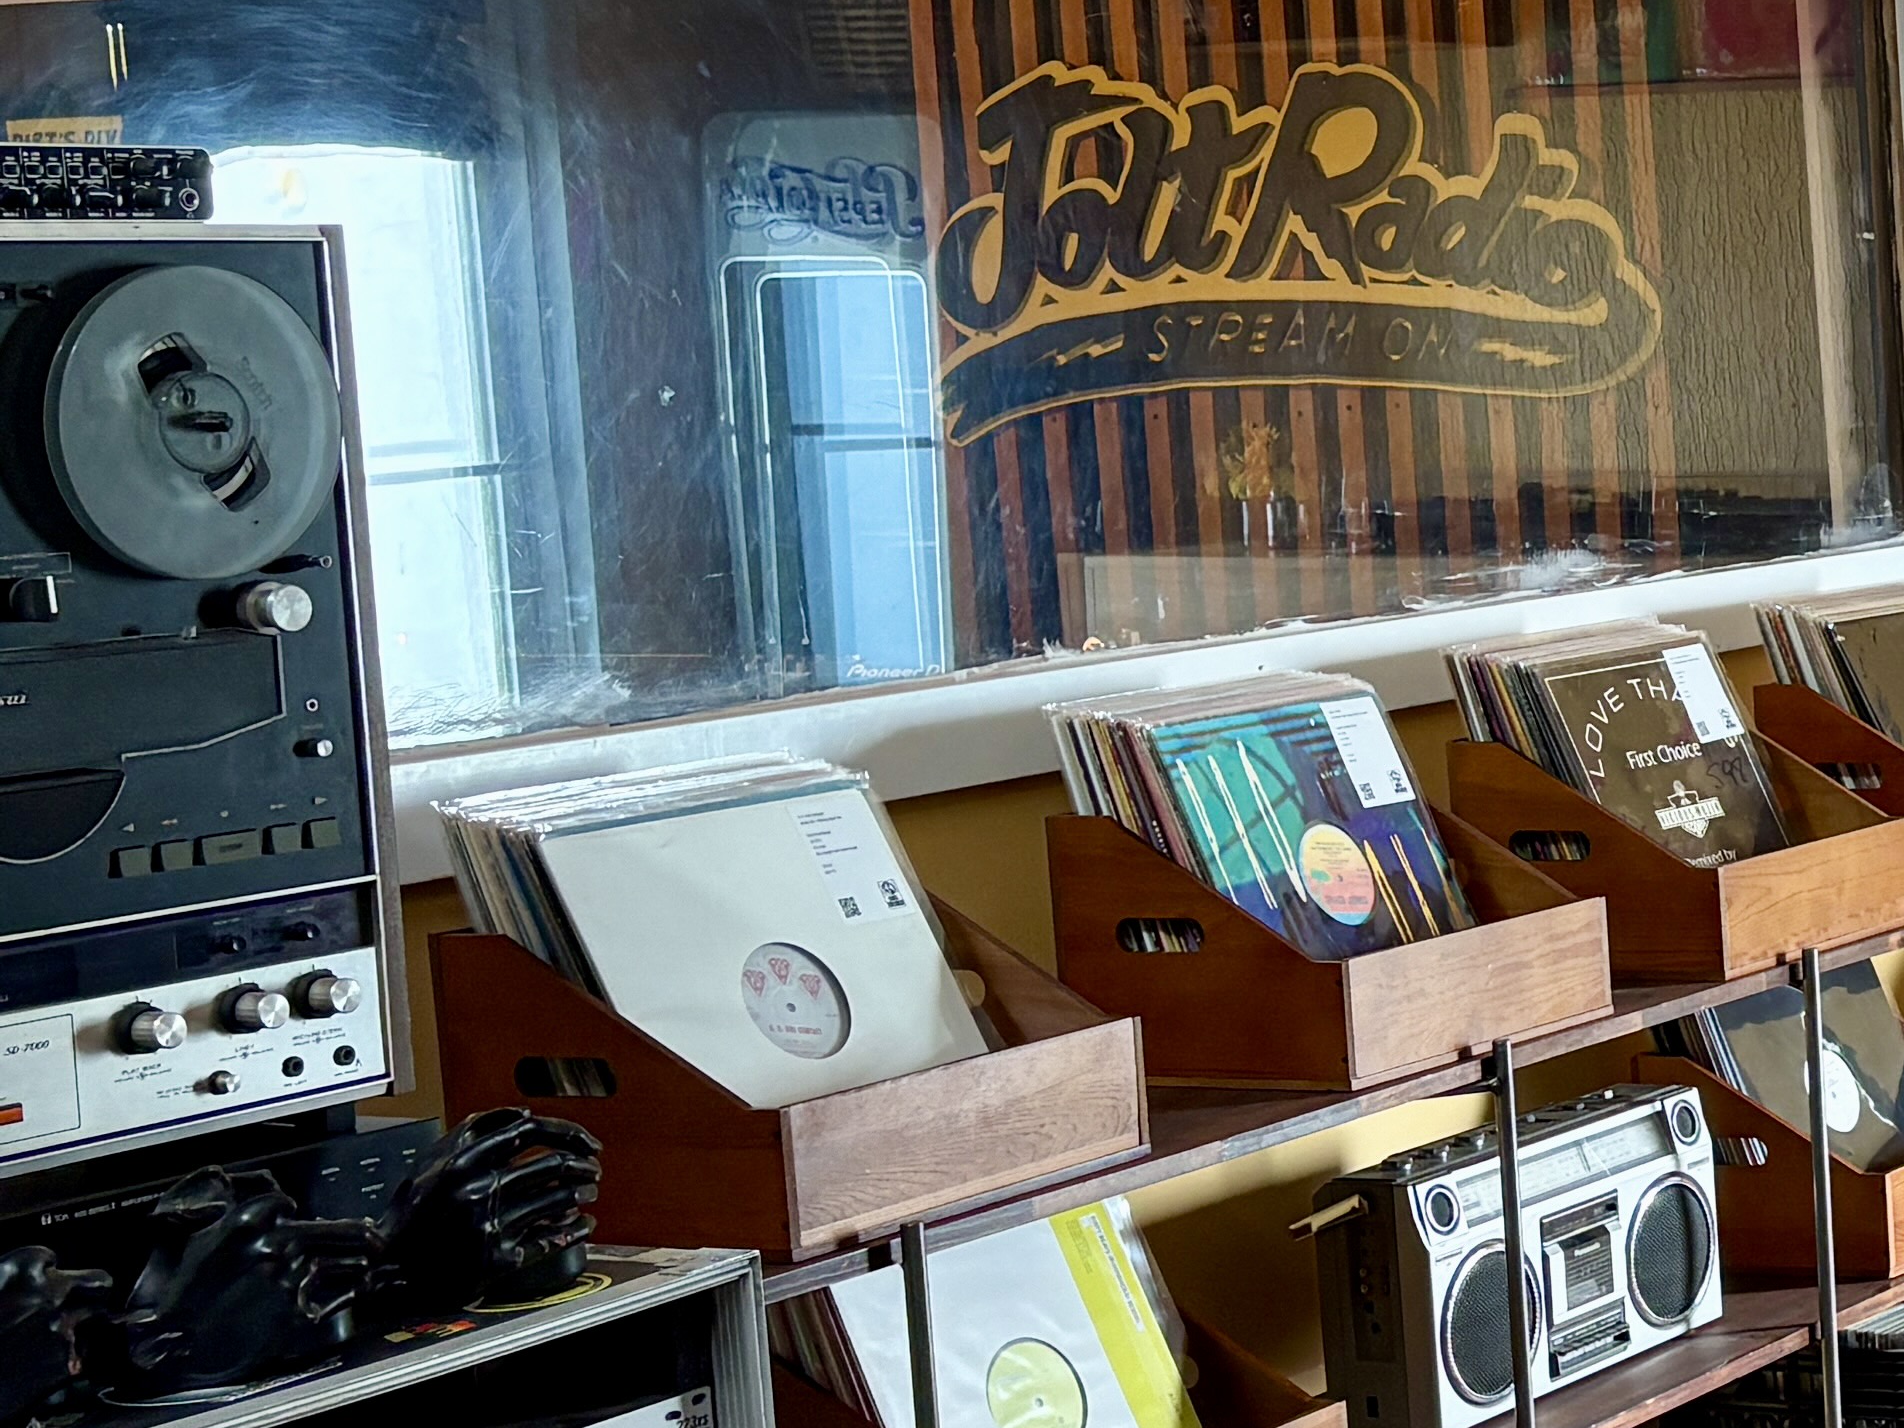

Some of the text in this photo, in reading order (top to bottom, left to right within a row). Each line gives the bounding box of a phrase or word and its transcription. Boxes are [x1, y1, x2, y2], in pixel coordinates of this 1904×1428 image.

[936, 60, 1626, 334] Jolt Radio
[1148, 310, 1454, 365] STREAM ON
[1584, 686, 1625, 779] LOVE
[1625, 740, 1703, 770] First Choice
[1660, 807, 1695, 829] VICIOUS
